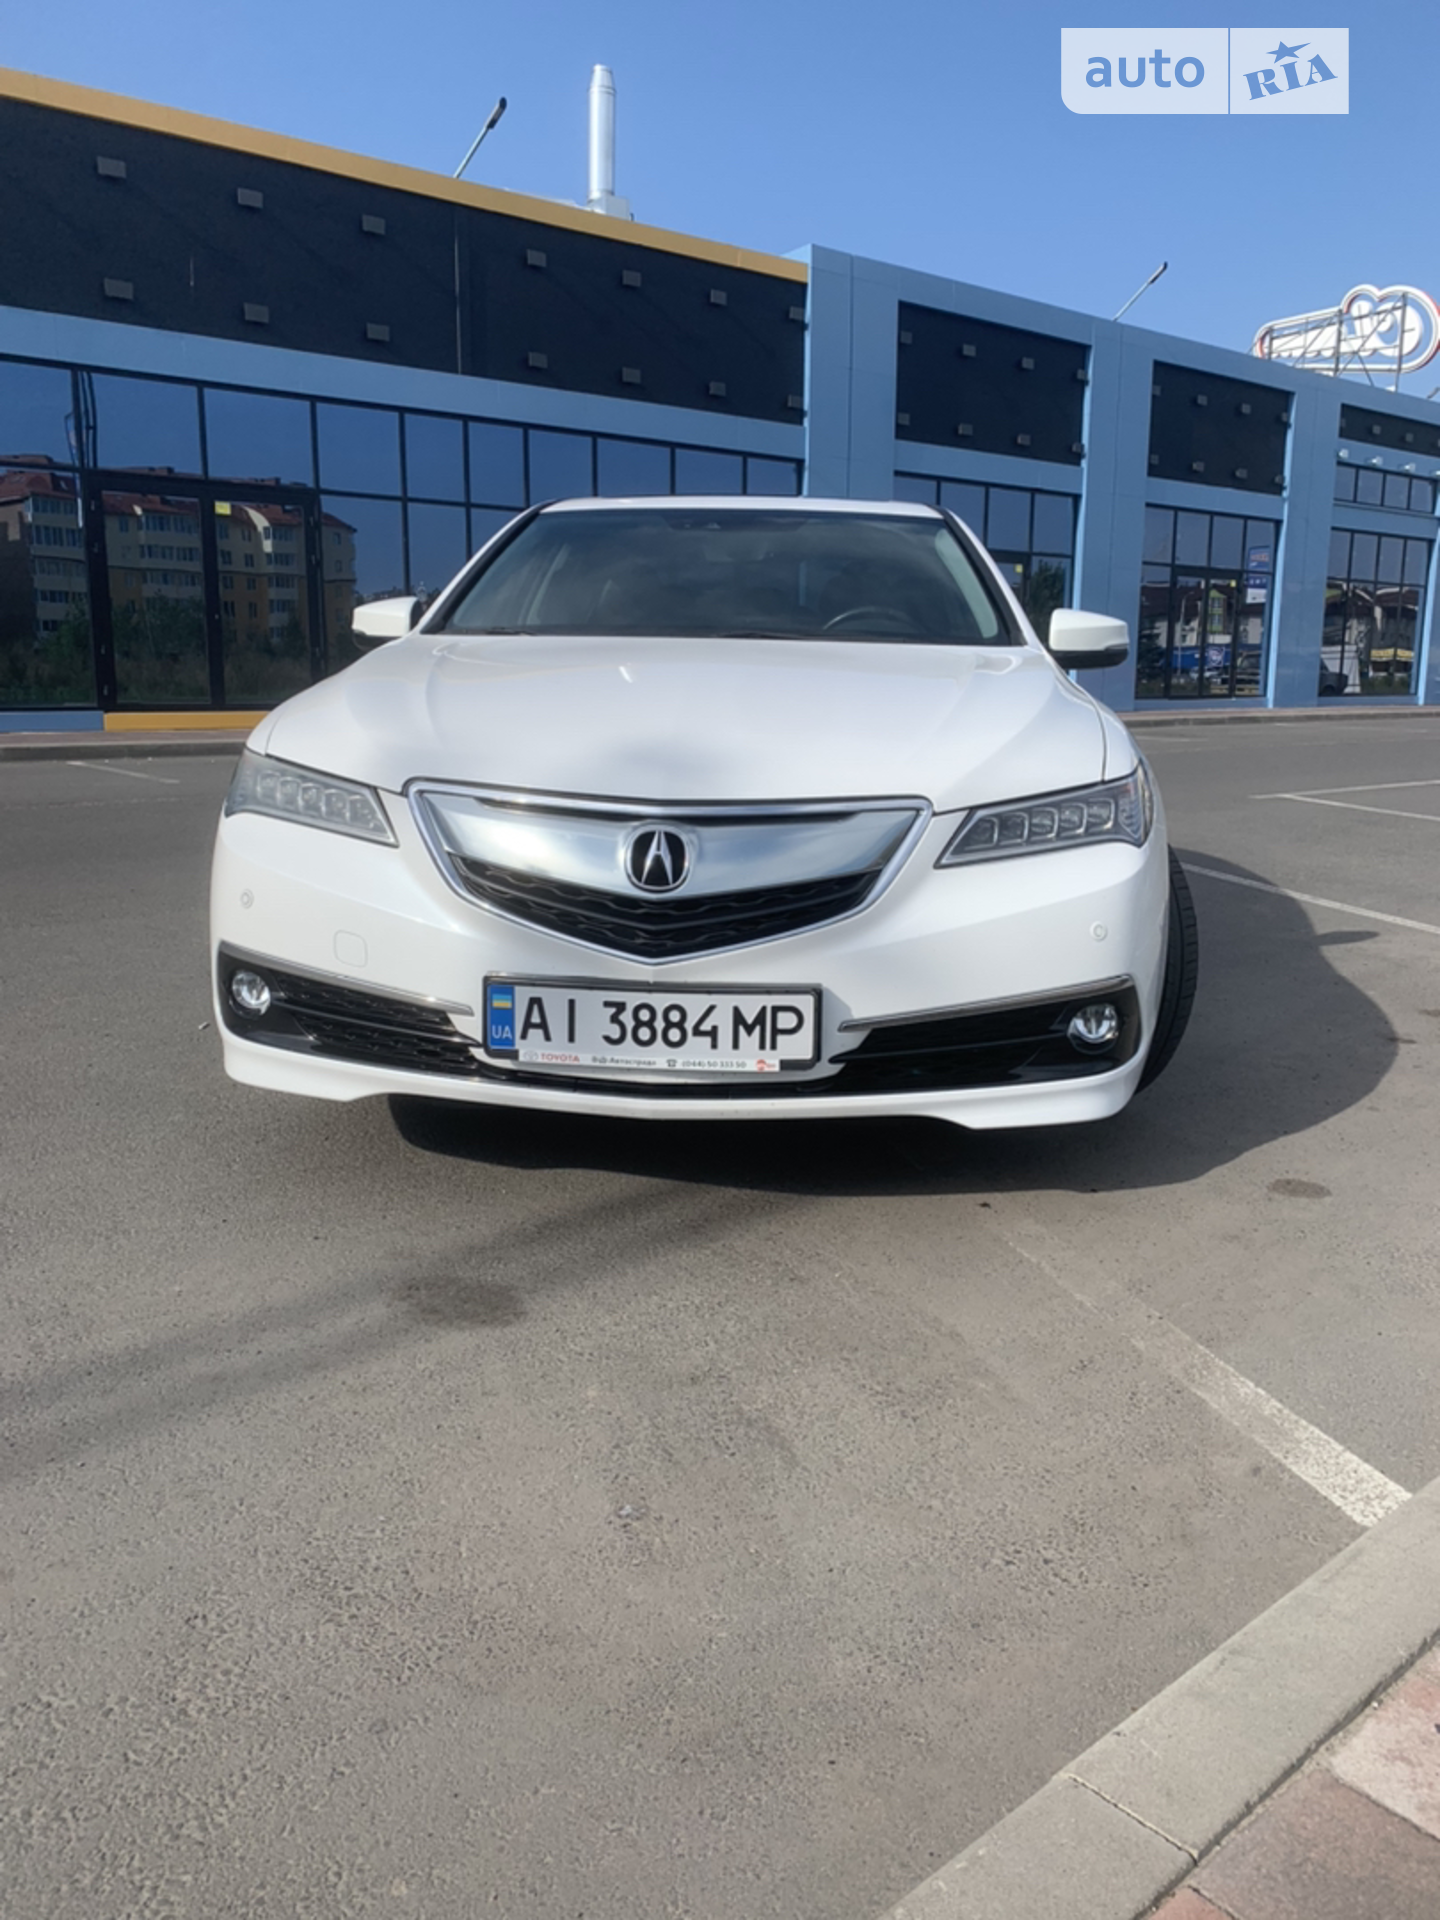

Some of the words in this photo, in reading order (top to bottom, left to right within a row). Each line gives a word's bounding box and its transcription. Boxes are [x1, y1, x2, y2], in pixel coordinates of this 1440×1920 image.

[492, 1025, 513, 1040] UA
[602, 1002, 718, 1050] 3884
[540, 1053, 580, 1064] TOYOTA
